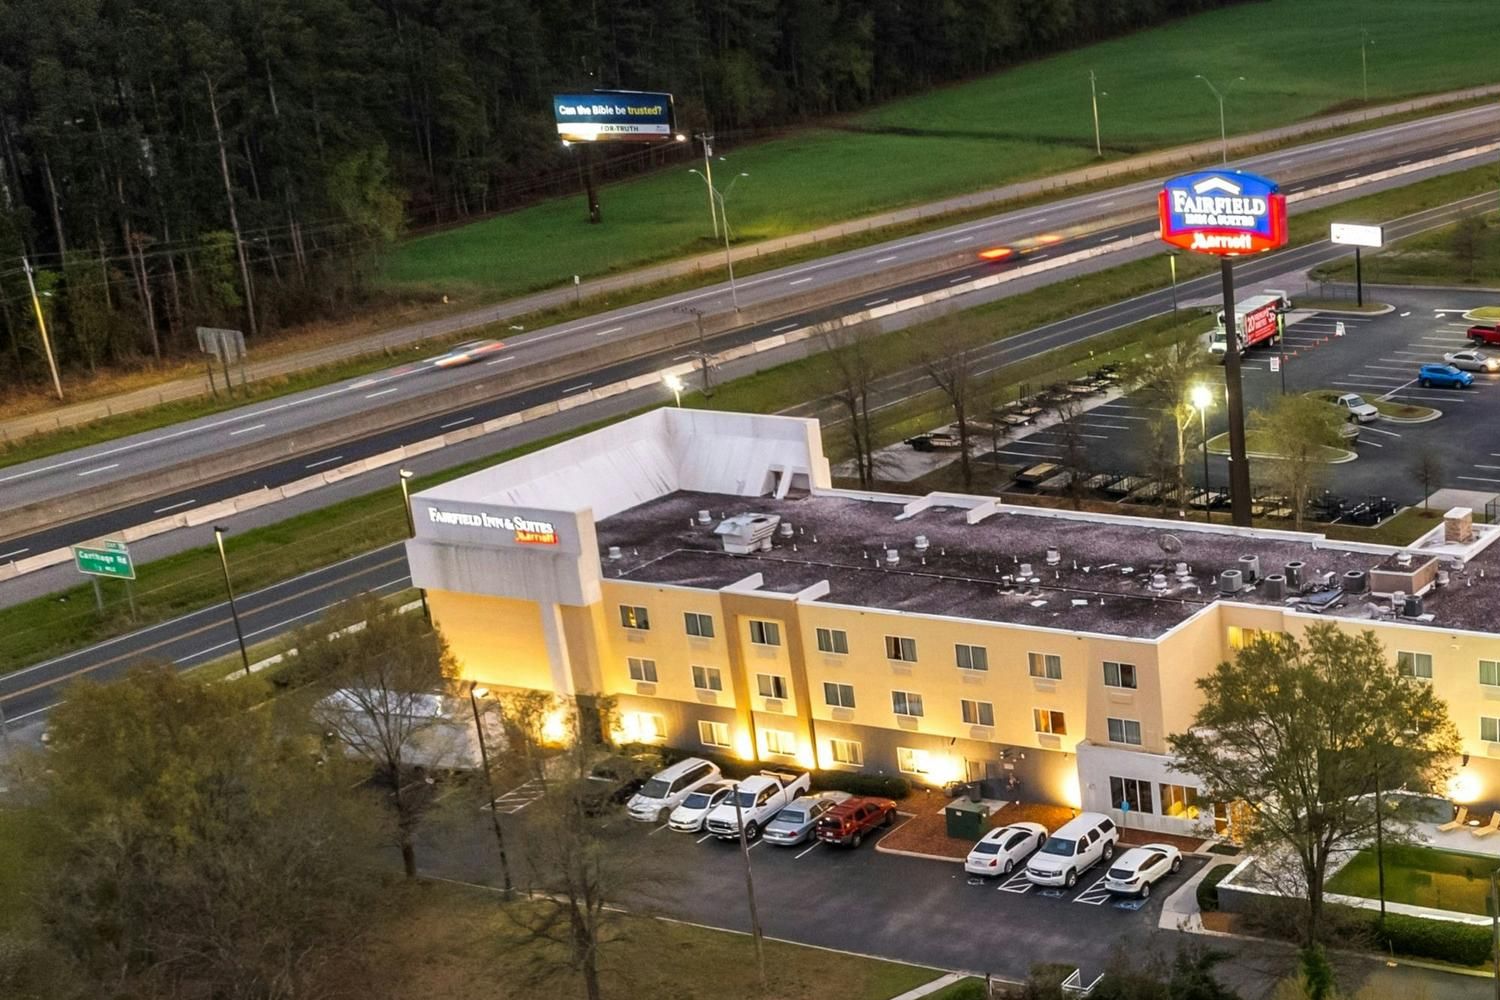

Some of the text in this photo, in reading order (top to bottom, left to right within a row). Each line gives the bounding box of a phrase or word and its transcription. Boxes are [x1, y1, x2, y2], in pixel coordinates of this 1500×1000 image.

[559, 105, 662, 115] Can the Bible be trusted?
[1172, 190, 1266, 215] FAIRFIELD
[428, 507, 553, 533] FAIRFIELD INN & SUITES
